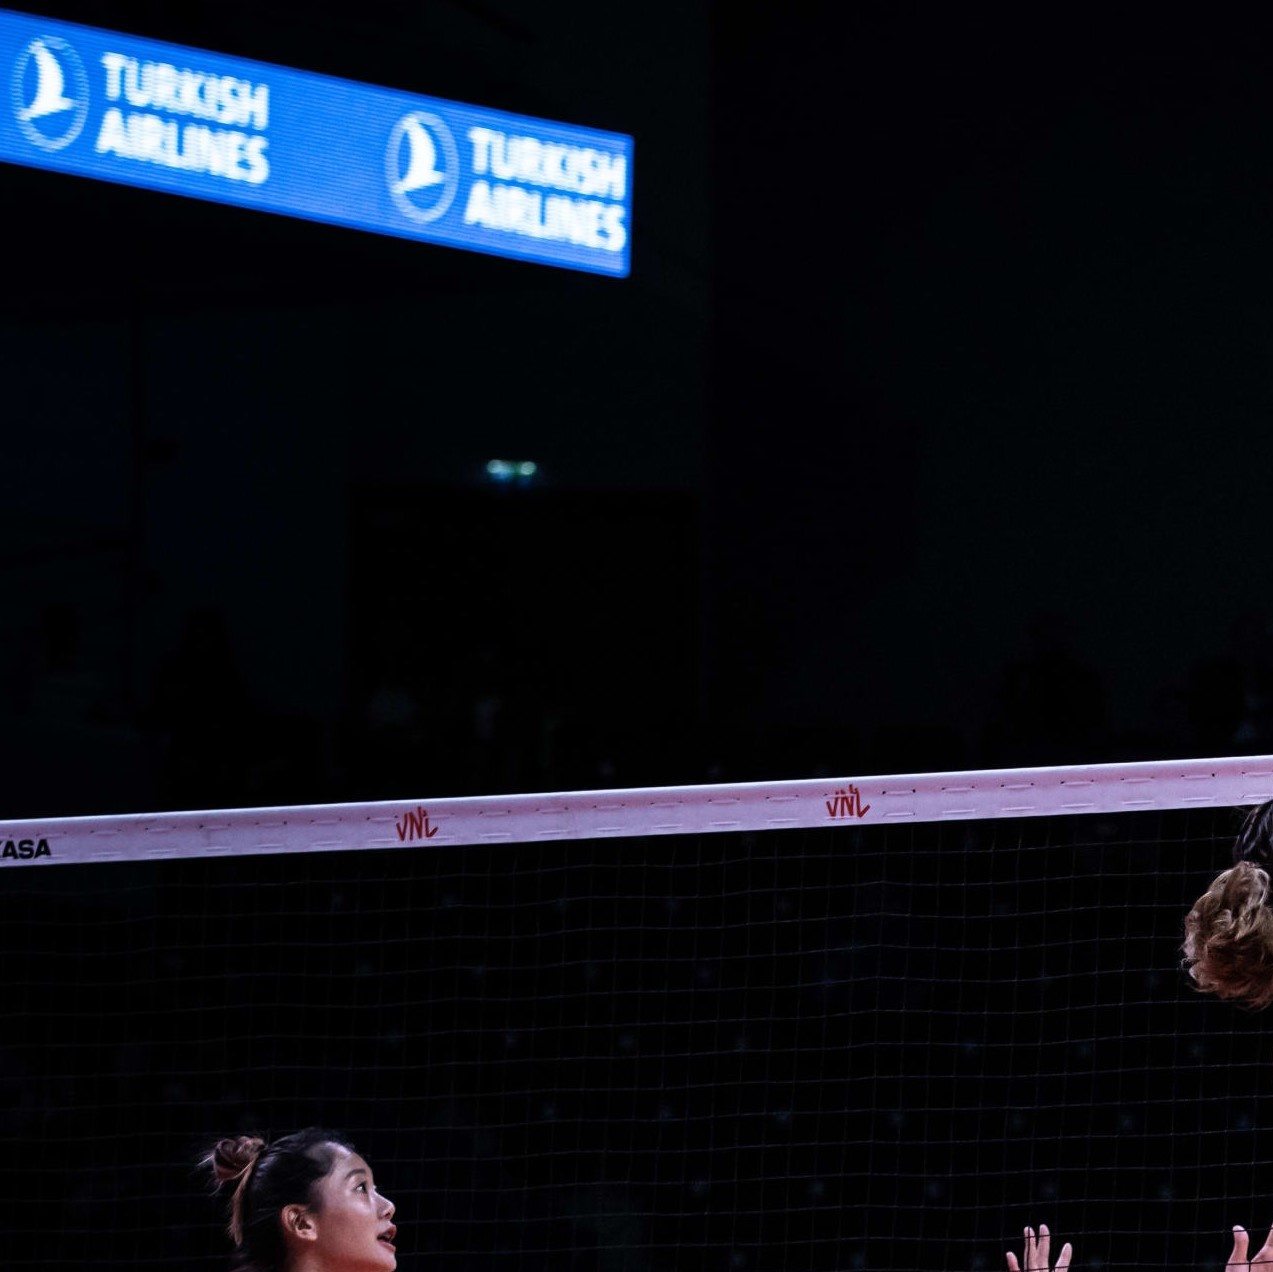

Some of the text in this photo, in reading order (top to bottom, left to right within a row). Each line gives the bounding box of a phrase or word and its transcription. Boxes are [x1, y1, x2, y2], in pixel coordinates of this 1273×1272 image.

[102, 52, 269, 130] TURKISH
[97, 108, 269, 186] AIRLINES
[468, 126, 626, 200] TURKISH
[464, 182, 626, 252] AIRLINES
[0, 838, 51, 859] ASA
